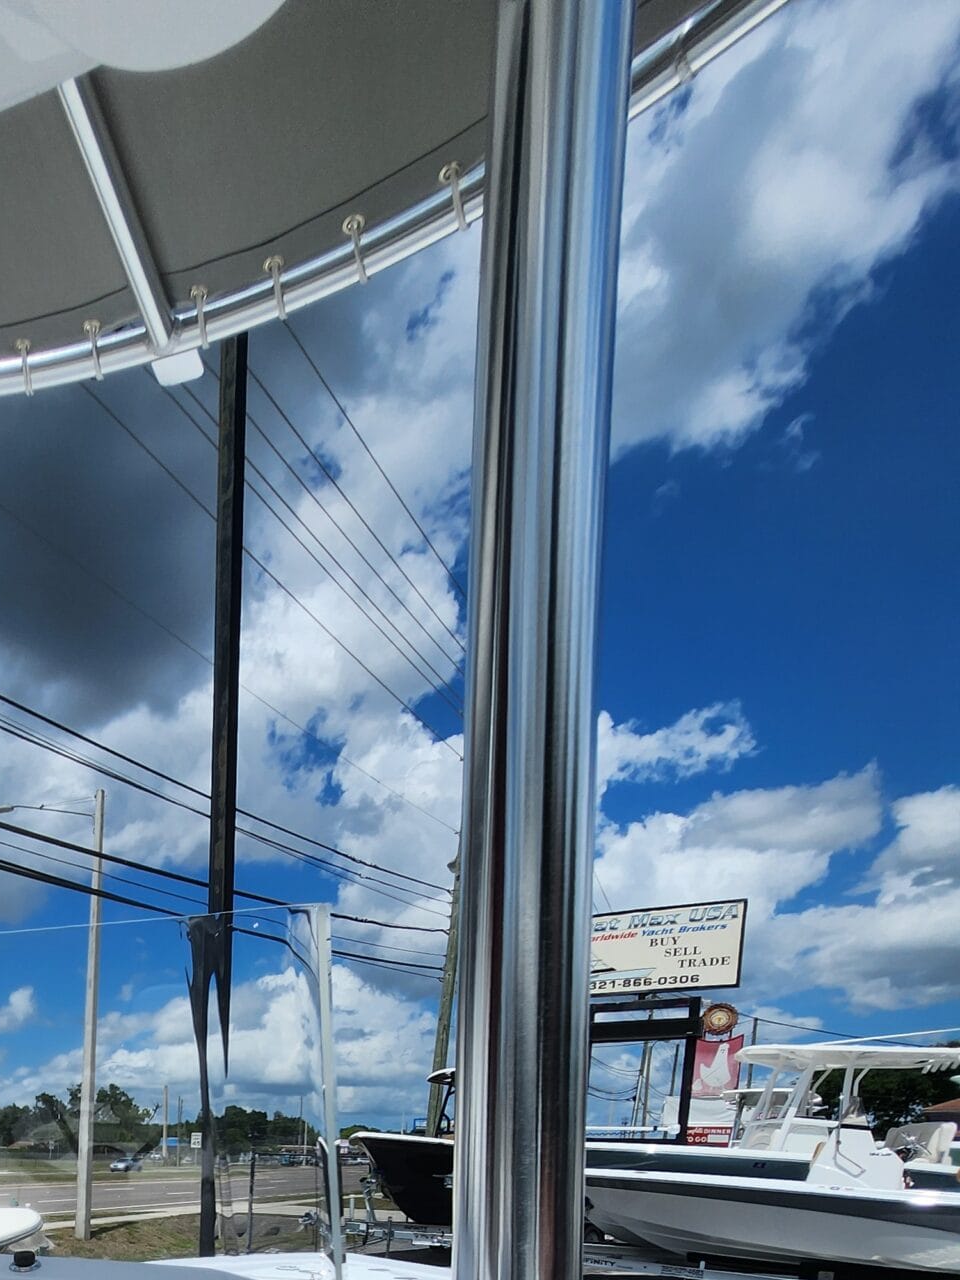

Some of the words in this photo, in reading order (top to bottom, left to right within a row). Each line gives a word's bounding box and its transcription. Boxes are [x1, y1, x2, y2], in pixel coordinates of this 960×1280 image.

[689, 904, 739, 922] USA
[641, 928, 674, 937] Yacht
[678, 922, 728, 934] Brokers
[649, 936, 680, 948] BUY
[663, 946, 702, 958] SELL
[677, 956, 731, 968] TRADE
[590, 974, 700, 990] 321-866-0306
